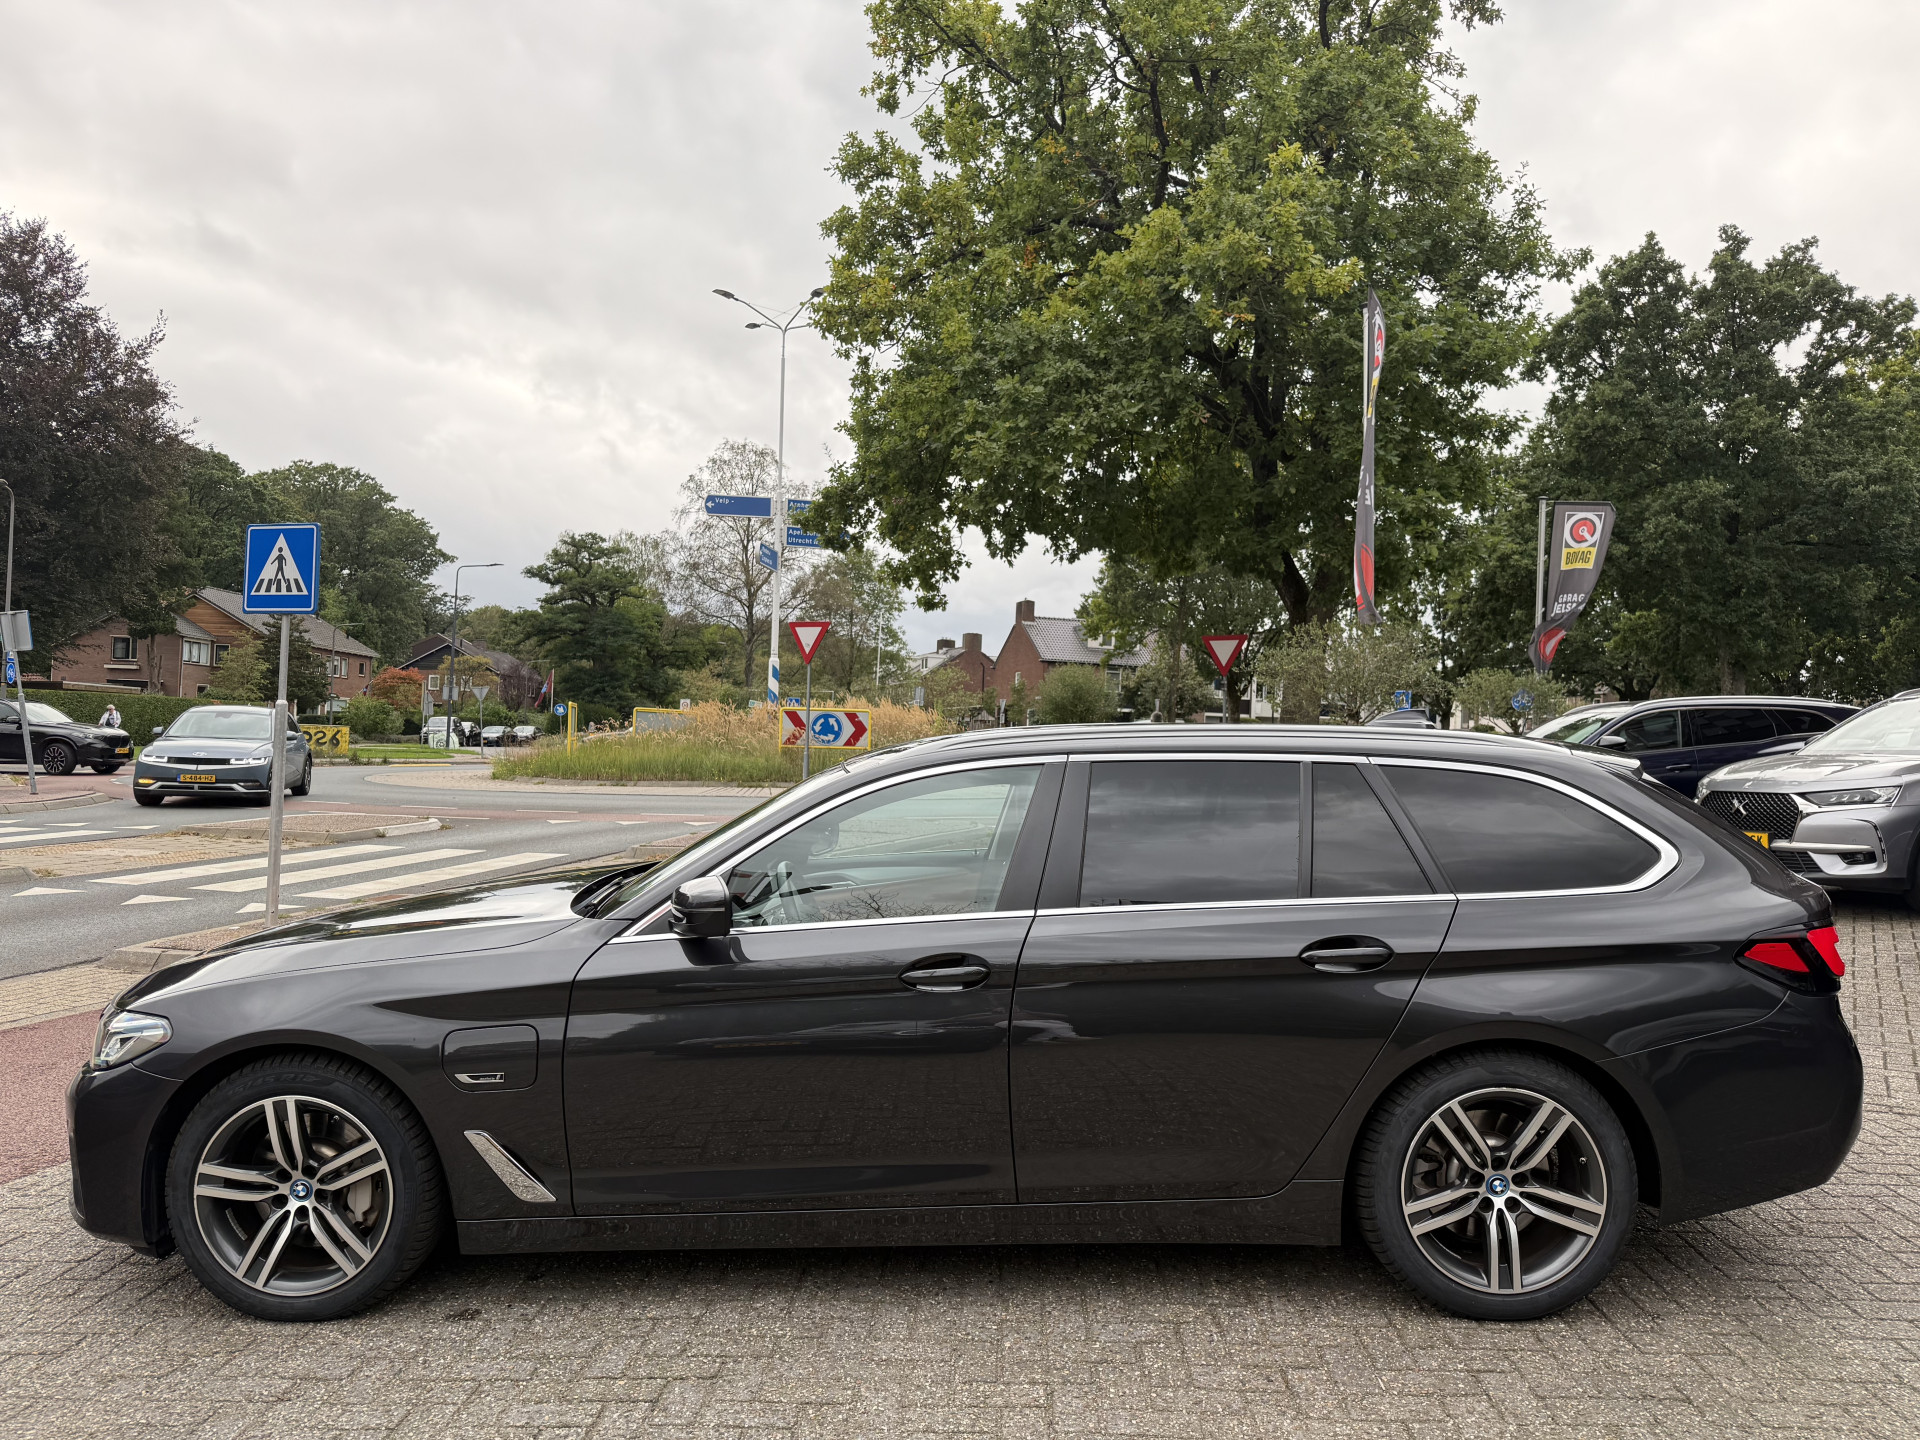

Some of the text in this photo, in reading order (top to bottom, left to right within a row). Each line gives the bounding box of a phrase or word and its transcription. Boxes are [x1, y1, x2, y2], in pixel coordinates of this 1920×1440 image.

[715, 497, 729, 505] Velp
[788, 536, 812, 545] Utrecht
[1565, 550, 1591, 565] BOVAG
[1558, 592, 1585, 603] GARAG
